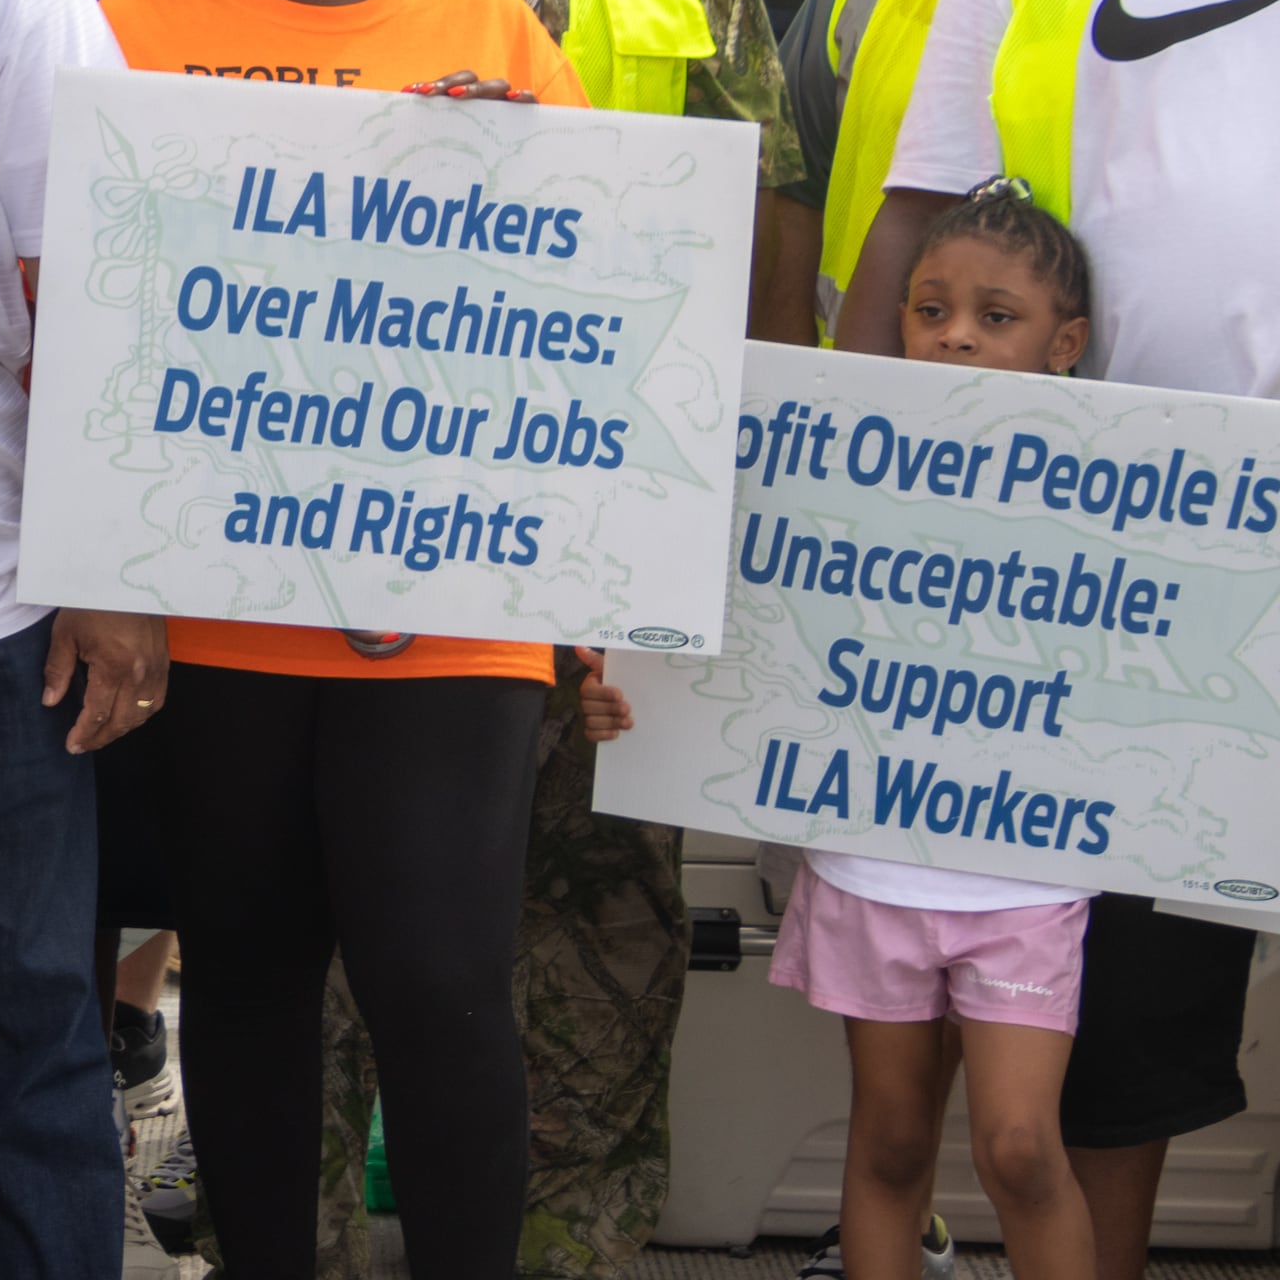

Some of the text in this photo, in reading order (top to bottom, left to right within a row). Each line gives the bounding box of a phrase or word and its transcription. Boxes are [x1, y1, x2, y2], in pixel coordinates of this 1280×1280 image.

[233, 167, 581, 258] ILA Workers
[178, 266, 622, 365] Over Machines:
[154, 368, 628, 469] Defend Our Jobs
[736, 401, 1280, 533] ofit Over People is
[224, 483, 543, 571] and Rights
[741, 513, 1179, 636] Unacceptable:
[818, 638, 1072, 736] Support
[756, 740, 1114, 855] ILA Workers
